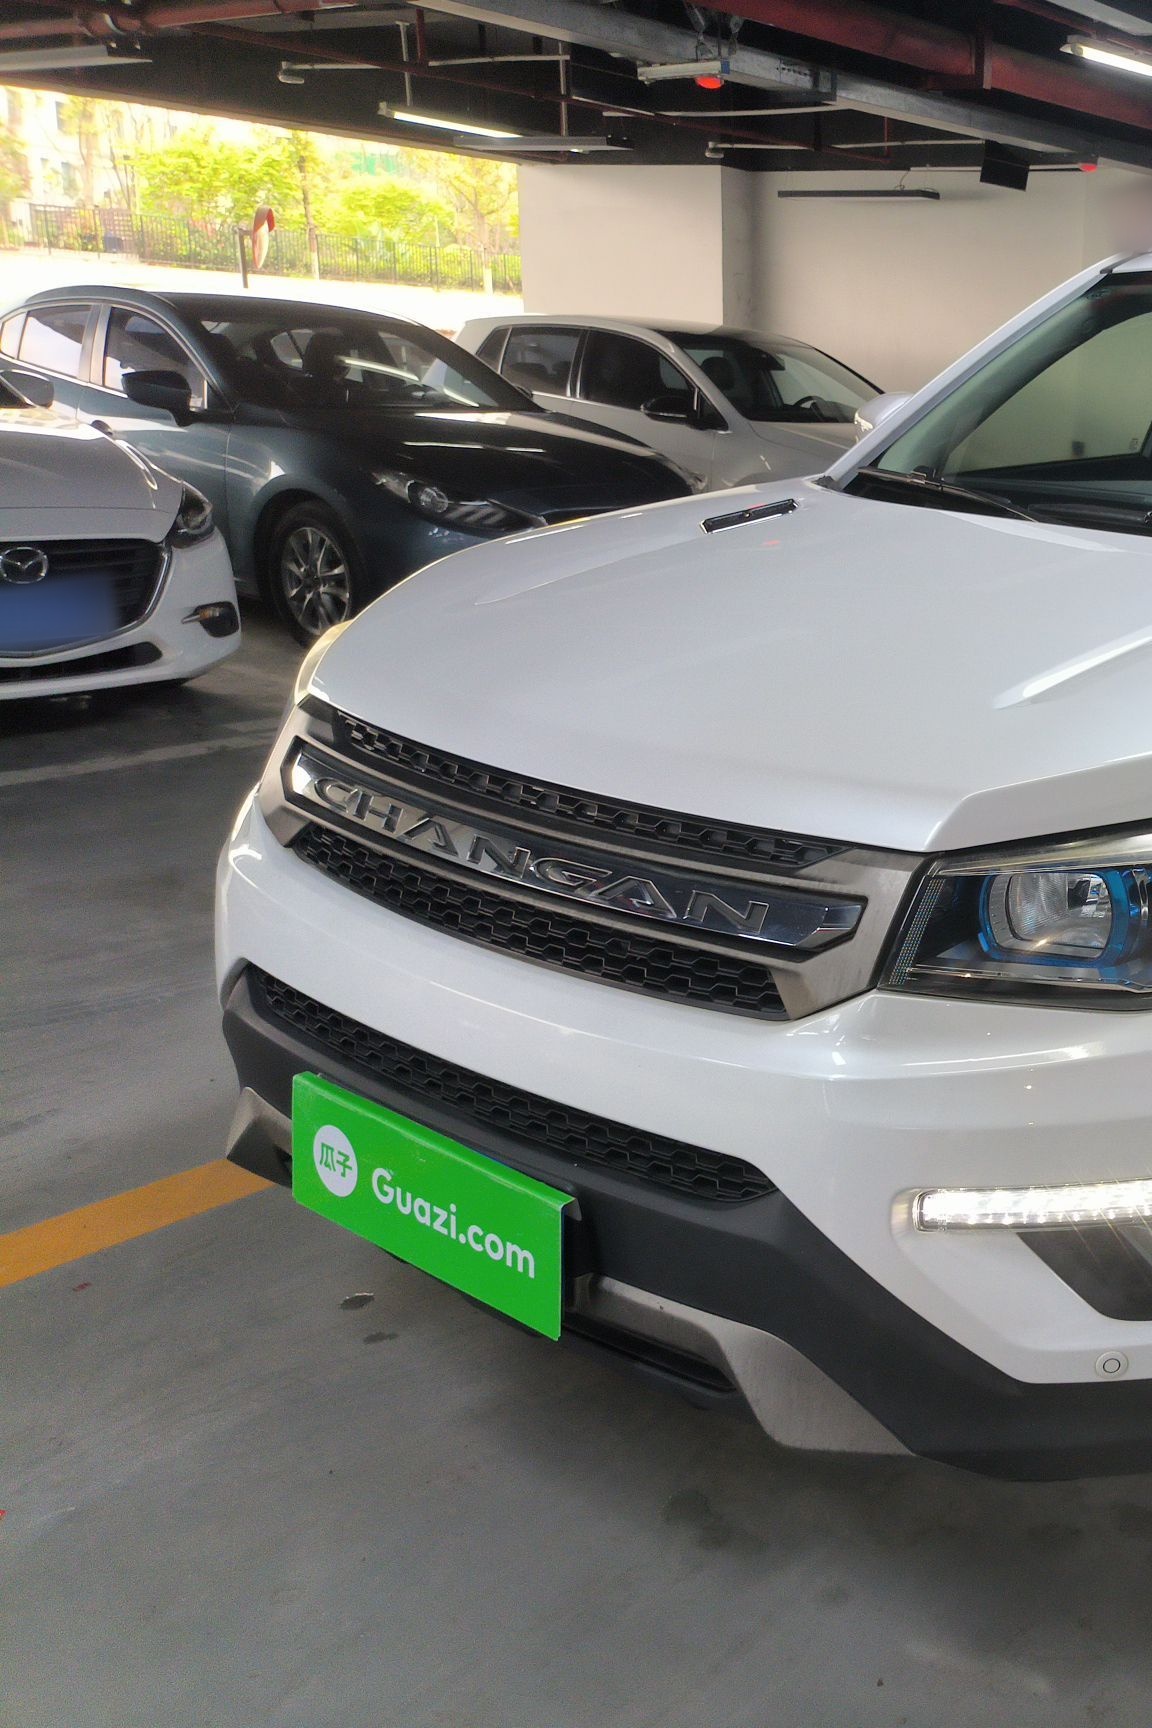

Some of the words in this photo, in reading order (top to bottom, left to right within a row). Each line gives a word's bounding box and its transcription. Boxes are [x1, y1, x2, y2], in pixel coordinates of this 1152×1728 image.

[312, 776, 770, 936] CHANGAN
[318, 1142, 353, 1178] 瓜子
[371, 1167, 536, 1279] Guazi.com
